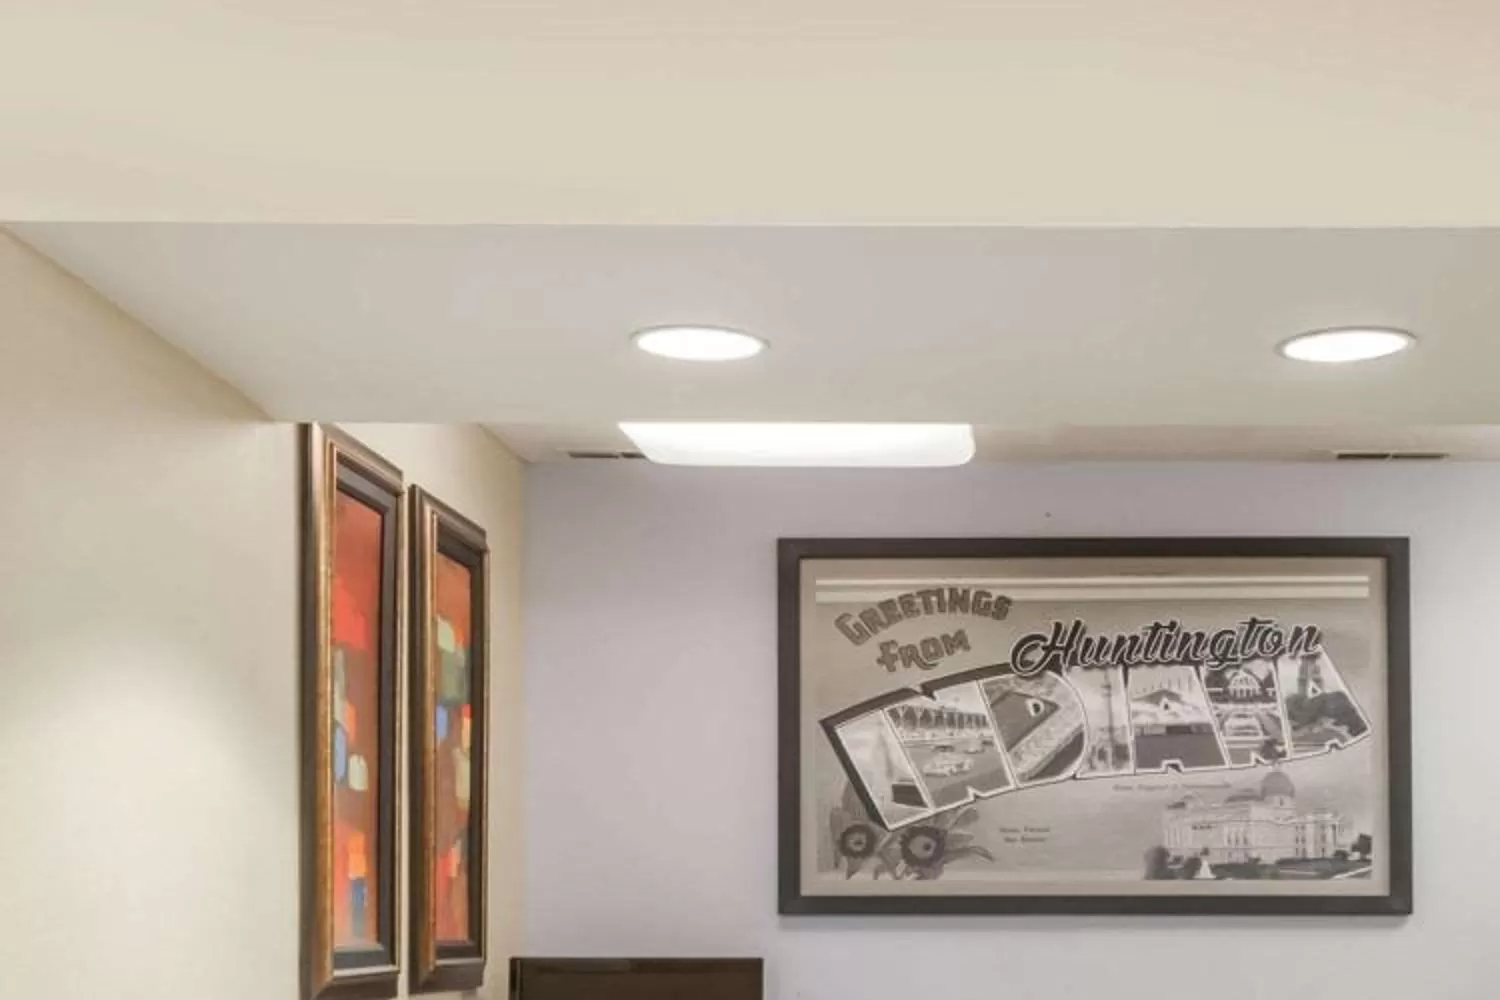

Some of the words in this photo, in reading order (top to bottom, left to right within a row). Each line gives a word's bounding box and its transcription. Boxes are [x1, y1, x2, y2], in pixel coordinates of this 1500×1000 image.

[834, 587, 1012, 646] GREETINGS
[876, 629, 972, 672] FROM
[1010, 615, 1325, 678] Huntington
